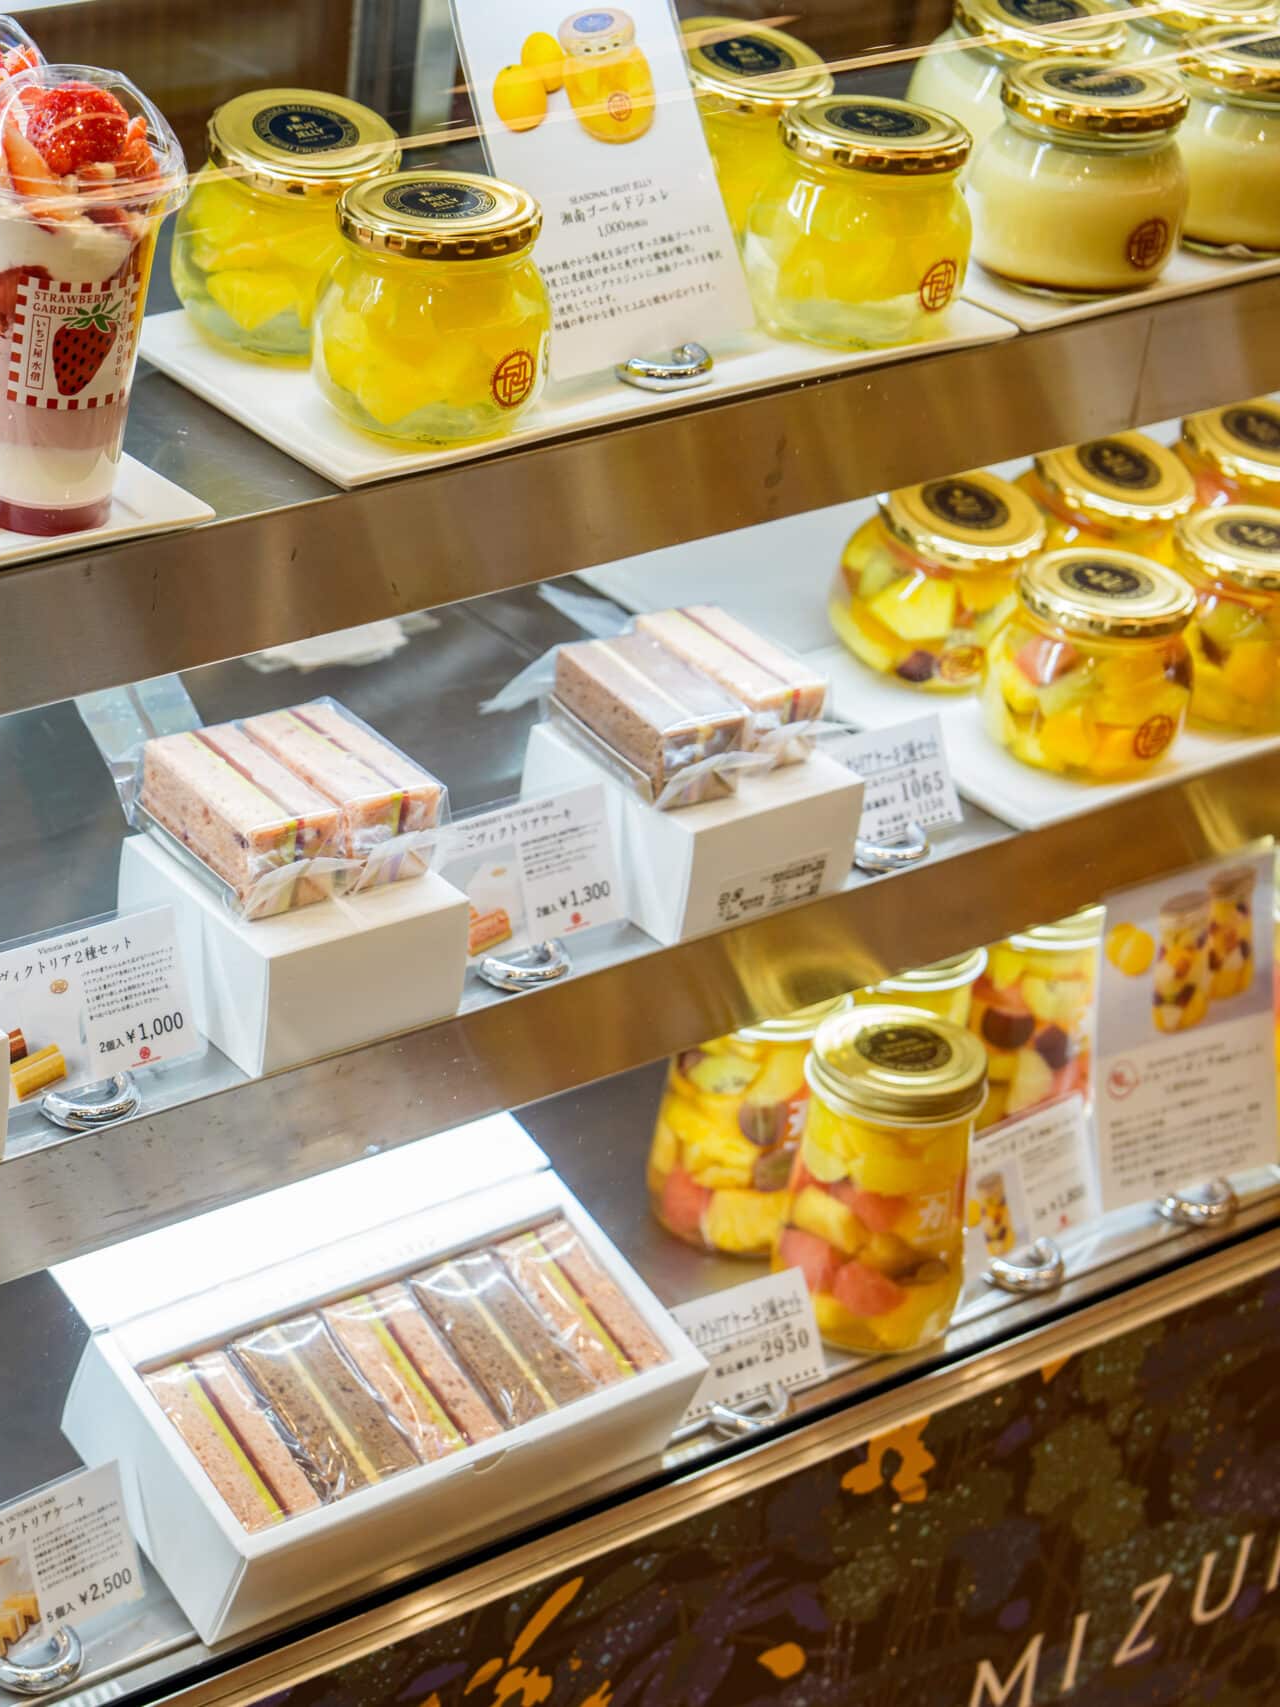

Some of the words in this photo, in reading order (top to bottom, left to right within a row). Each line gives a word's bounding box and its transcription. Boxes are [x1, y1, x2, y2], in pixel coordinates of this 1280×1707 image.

[560, 190, 669, 226] 湘南ゴールドジュレ
[32, 302, 83, 316] GARDEN
[901, 771, 945, 801] 1065
[560, 880, 611, 910] ¥1,300
[99, 1038, 125, 1054] 2個入
[126, 1011, 184, 1045] ¥1,000
[762, 1328, 810, 1363] 2950
[46, 1602, 76, 1624] 5個入
[79, 1567, 133, 1606] ¥2,500
[968, 1532, 1280, 1707] MIZU
